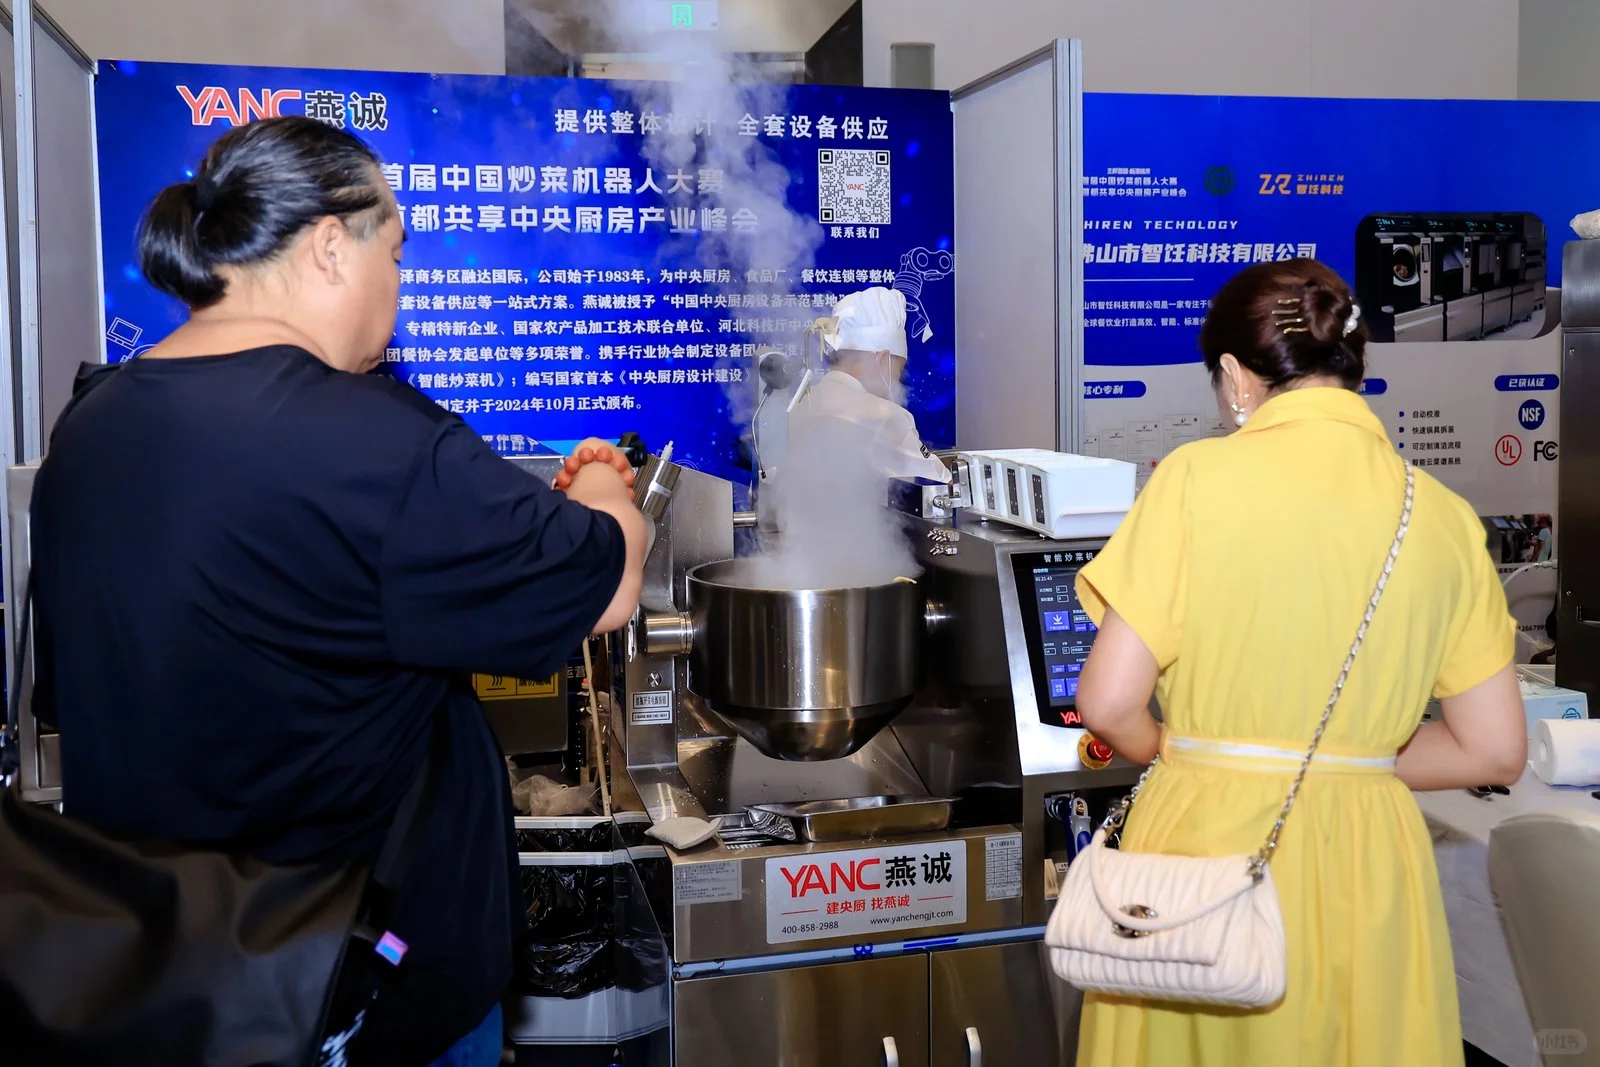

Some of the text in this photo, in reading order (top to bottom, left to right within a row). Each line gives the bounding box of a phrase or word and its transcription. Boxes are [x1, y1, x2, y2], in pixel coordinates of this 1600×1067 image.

[176, 86, 389, 131] YANC 燕诚
[555, 109, 889, 140] 提供整体设计 全套设备供应
[380, 163, 725, 195] 首届中国炒菜机器人大赛
[396, 204, 759, 234] 都共享中央厨房产业峰会
[1144, 220, 1239, 230] TECHOLOGY
[830, 226, 880, 239] 联系我们
[1521, 407, 1541, 422] NSF
[1043, 552, 1094, 563] 智能炒菜机
[780, 858, 881, 898] YANC
[885, 852, 952, 889] 燕诚
[826, 895, 911, 915] 建央厨 找燕诚
[781, 910, 954, 934] 400-858-2988 www.yanchengjt.com
